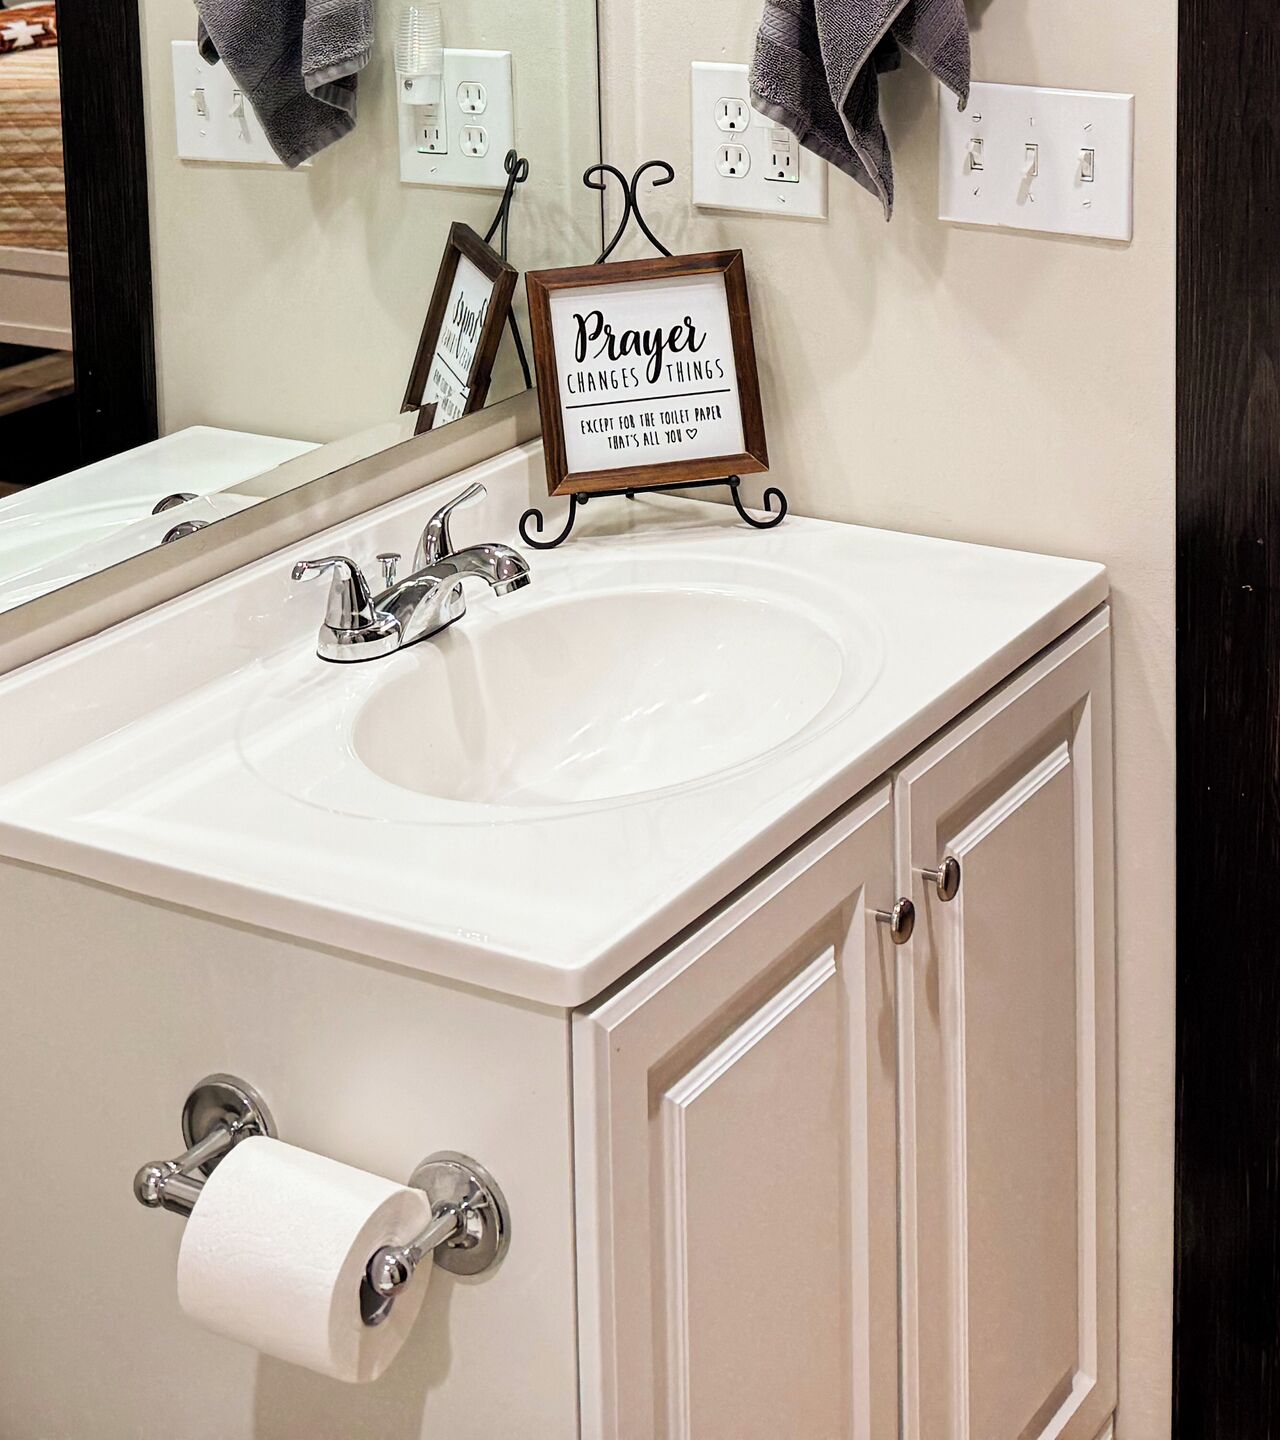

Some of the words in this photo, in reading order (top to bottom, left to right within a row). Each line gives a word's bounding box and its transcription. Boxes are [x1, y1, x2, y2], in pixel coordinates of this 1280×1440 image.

[573, 310, 707, 384] Prayer
[567, 367, 639, 394] CHANGES
[666, 359, 724, 383] THINGS
[580, 417, 614, 435] EXCEPT
[619, 414, 635, 430] FOR
[640, 412, 655, 427] THE
[660, 409, 689, 425] TOILET
[695, 405, 722, 422] PAPER
[607, 433, 640, 450] THAT'S
[644, 431, 660, 447] ALL
[665, 429, 682, 444] YOU
